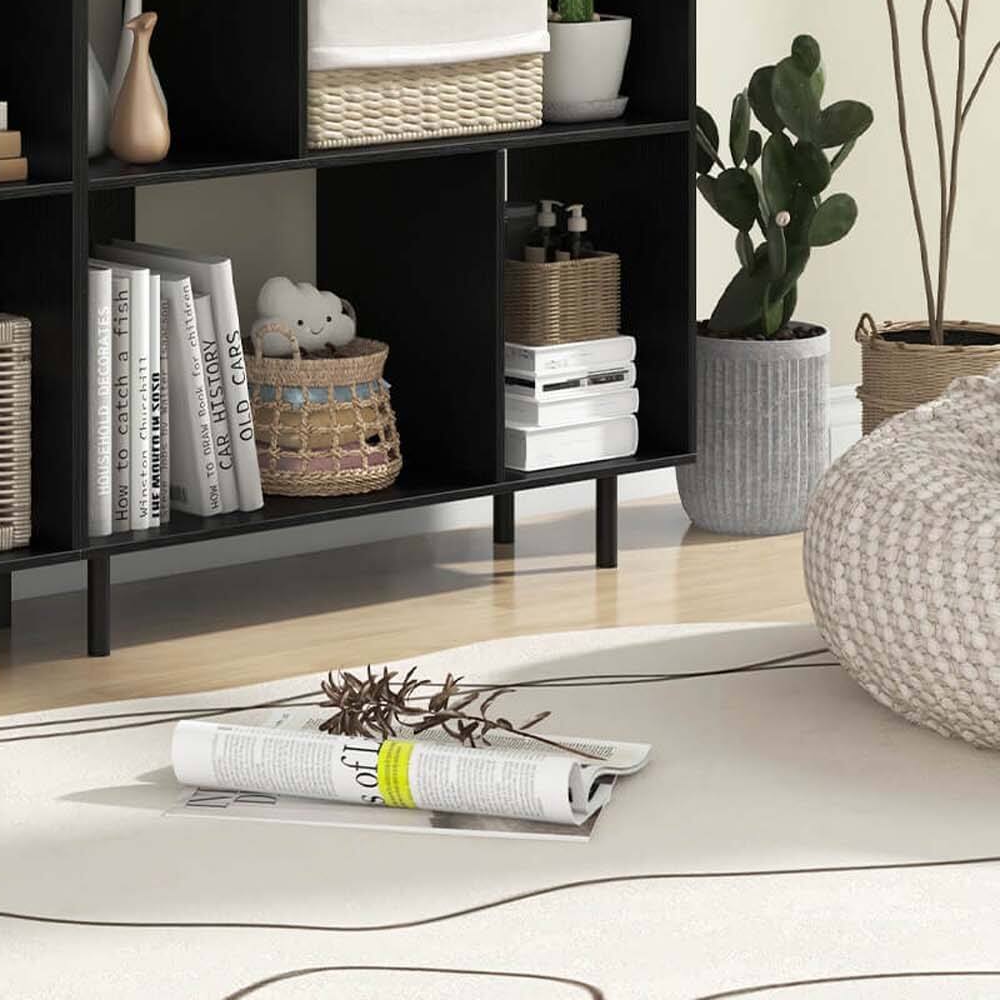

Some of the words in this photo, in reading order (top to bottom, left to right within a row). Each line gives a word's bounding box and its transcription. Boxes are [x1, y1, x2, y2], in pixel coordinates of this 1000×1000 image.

[113, 290, 129, 336] fish
[183, 285, 197, 347] children
[118, 351, 129, 362] a
[226, 330, 246, 385] CARS
[139, 357, 148, 441] Churchill
[203, 340, 226, 423] HISTORY
[113, 376, 129, 435] catch
[236, 399, 253, 441] OLD
[116, 448, 129, 471] to
[200, 423, 212, 456] DRAW
[216, 433, 233, 470] CAR
[139, 450, 149, 518] Winston
[205, 462, 215, 478] TO
[115, 485, 129, 521] How
[209, 485, 219, 509] HOW
